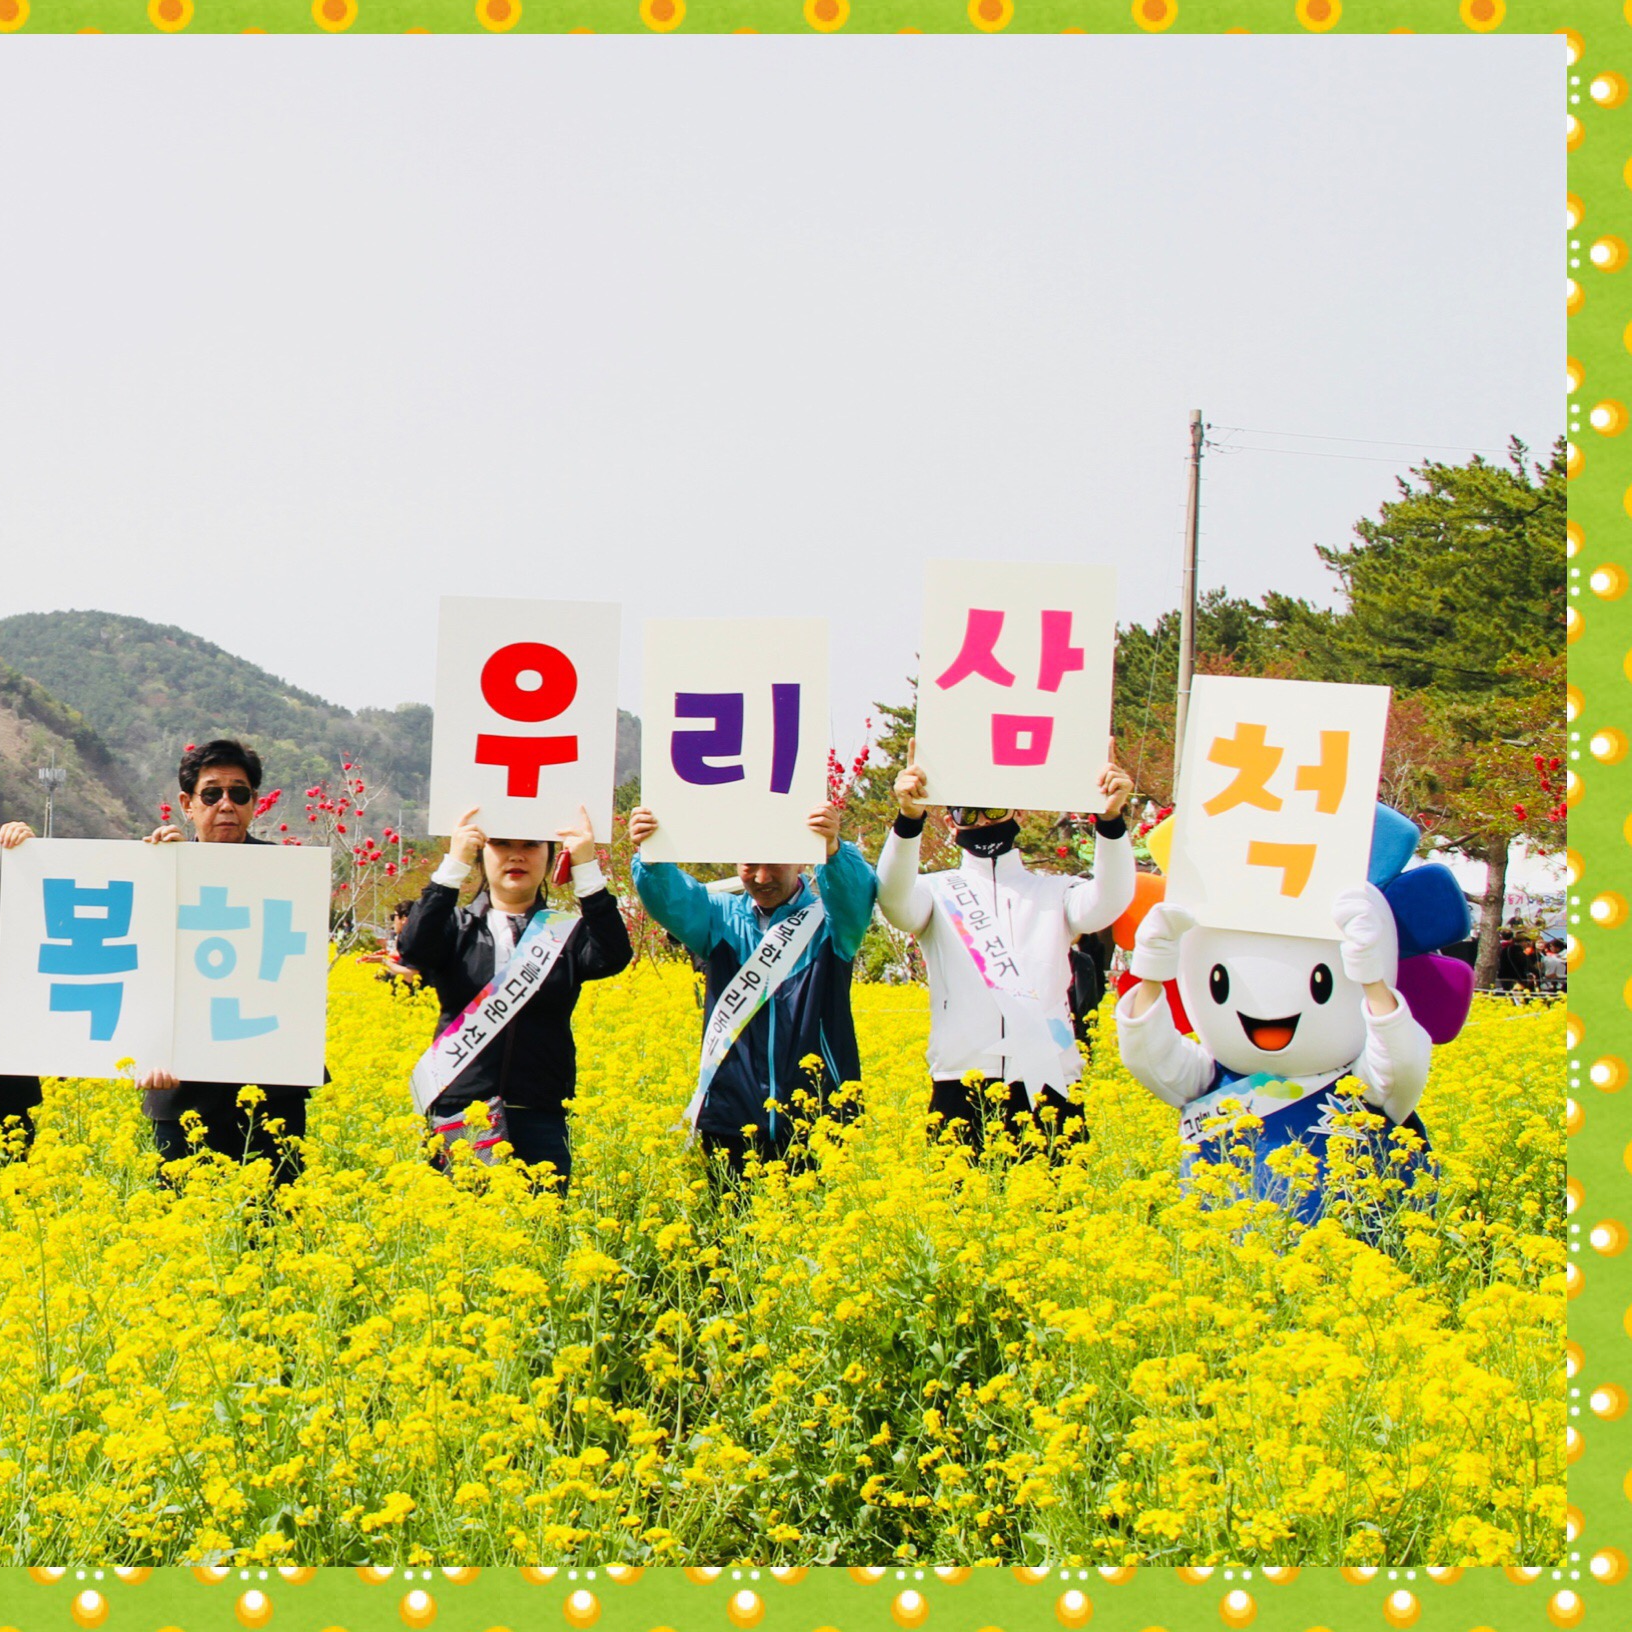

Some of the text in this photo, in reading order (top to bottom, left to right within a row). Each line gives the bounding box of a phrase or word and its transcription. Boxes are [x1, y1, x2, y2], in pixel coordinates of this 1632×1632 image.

[474, 641, 579, 799] 우
[670, 683, 801, 795] 리
[934, 608, 1085, 766] 삼
[1202, 722, 1351, 899] 척
[38, 878, 139, 1042] 복
[178, 885, 307, 1042] 한
[445, 944, 551, 1069] 아름다운 선거
[984, 935, 1020, 977] 선거
